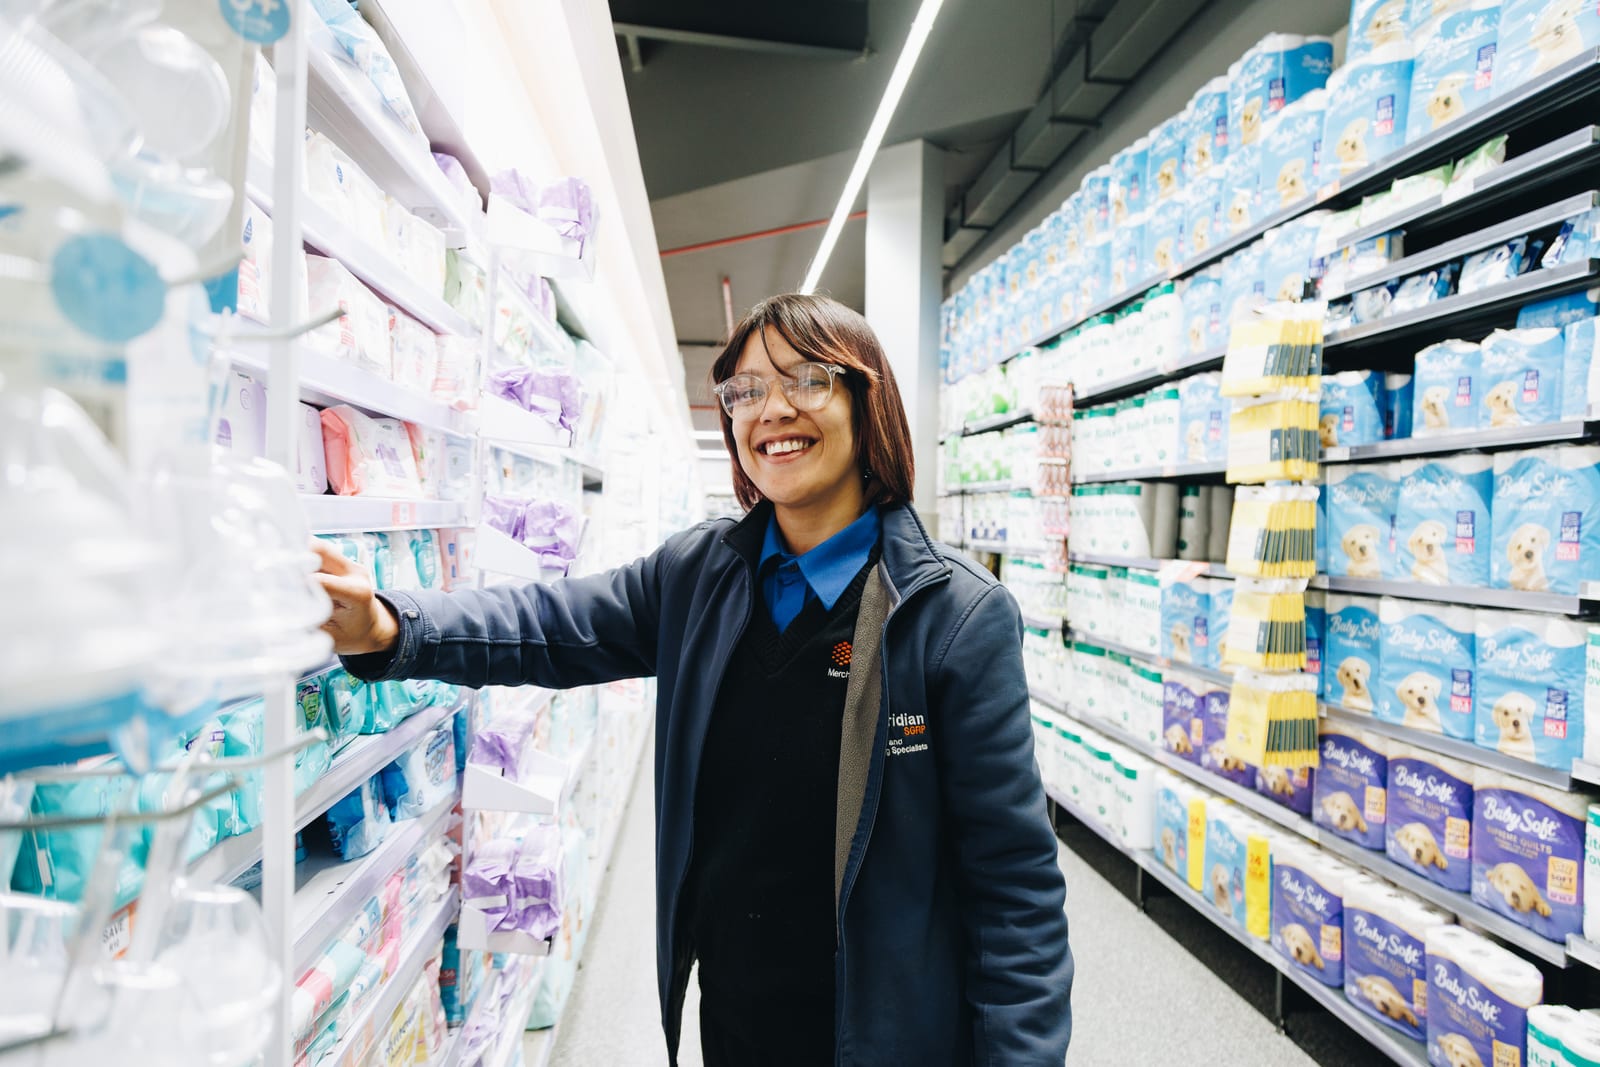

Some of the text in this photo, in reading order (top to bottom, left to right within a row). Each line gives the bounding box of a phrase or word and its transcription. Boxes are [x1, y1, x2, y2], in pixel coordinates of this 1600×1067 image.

[1330, 616, 1358, 637] Baby
[1389, 624, 1458, 655] Baby Soft
[1482, 638, 1554, 671] Baby Soft
[888, 738, 903, 746] and
[904, 725, 926, 736] SGRP
[891, 743, 928, 755] Specialists
[1323, 740, 1372, 773] Baby Soft
[1395, 764, 1425, 796] Baby
[1425, 775, 1453, 803] Soft
[1483, 796, 1556, 839] Baby Soft
[1281, 870, 1305, 901] Baby
[1304, 885, 1327, 911] Soft
[103, 918, 124, 944] SAVE
[1353, 914, 1387, 950] Baby
[1387, 934, 1419, 964] Soft
[1434, 963, 1467, 1004] Baby
[1466, 986, 1498, 1021] Soft
